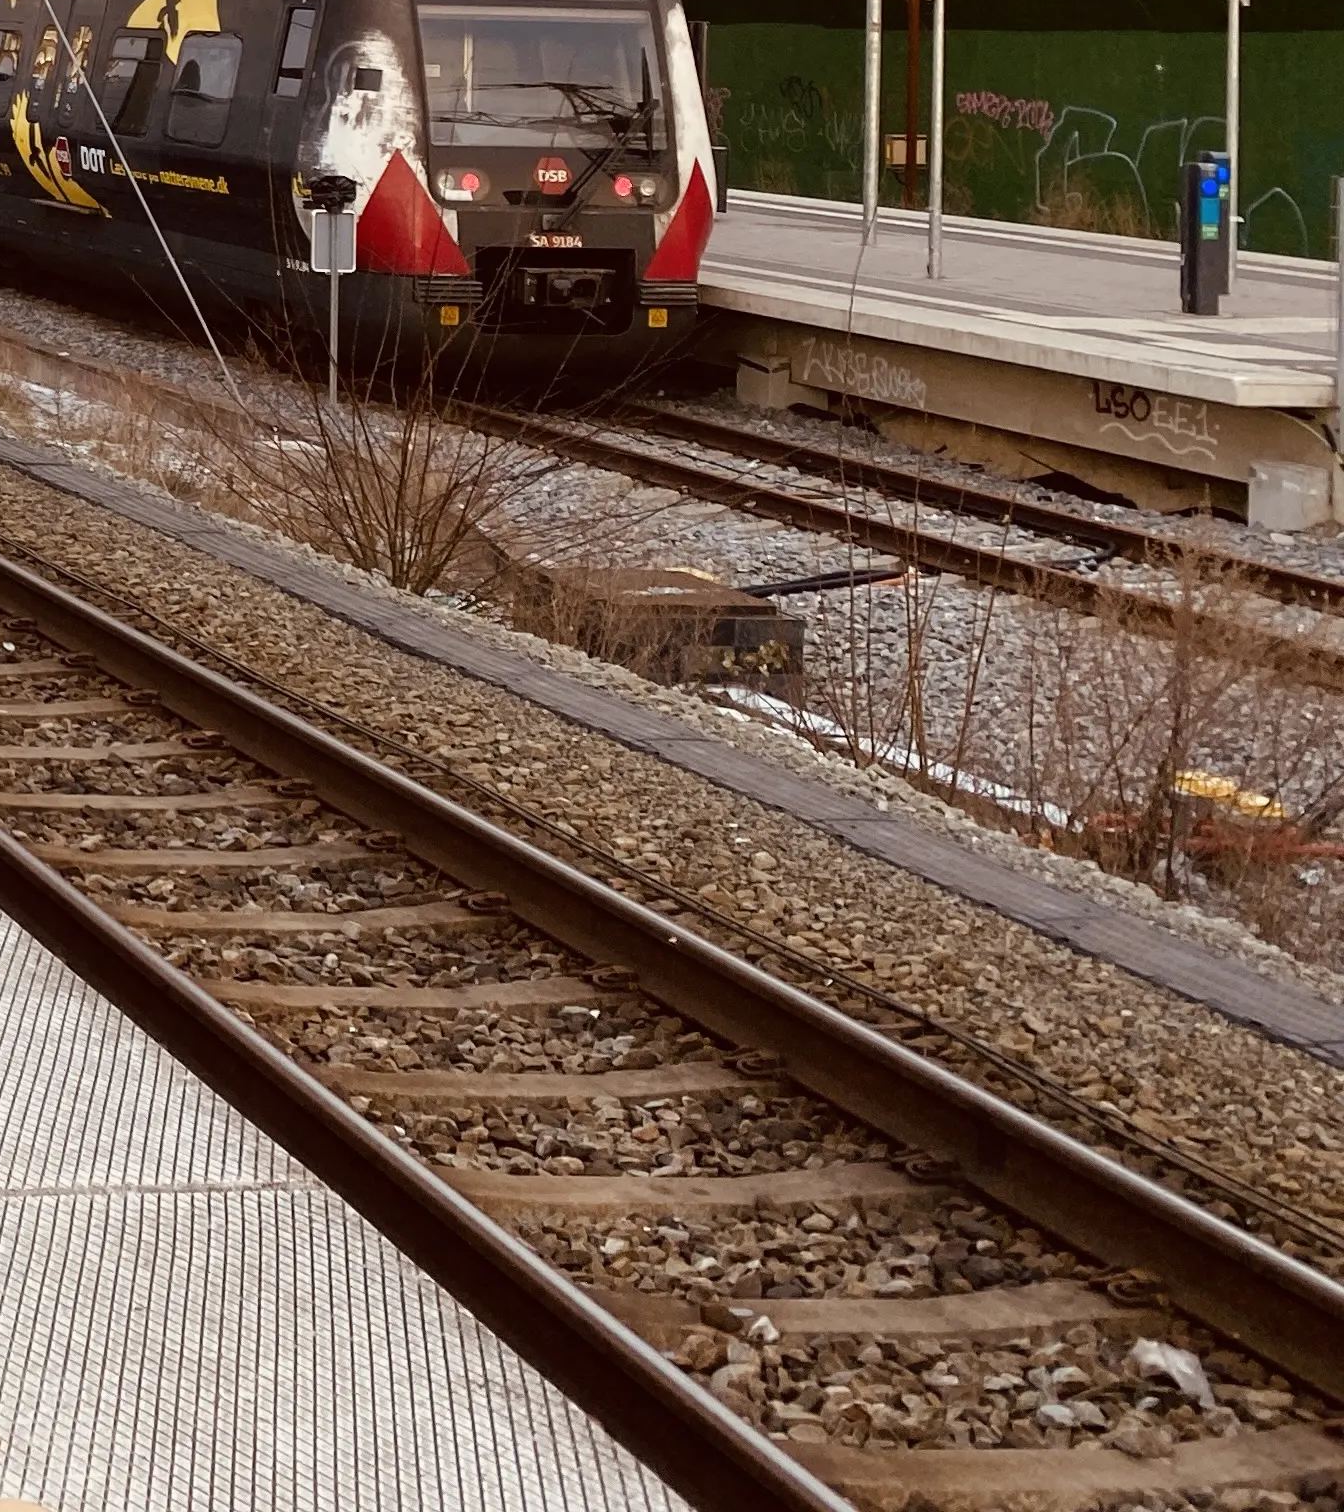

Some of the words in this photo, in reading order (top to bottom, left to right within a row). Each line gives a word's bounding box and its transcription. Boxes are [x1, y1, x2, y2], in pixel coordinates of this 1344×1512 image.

[80, 145, 106, 175] DOT
[538, 169, 568, 183] DSB
[531, 236, 549, 248] SA
[552, 236, 583, 248] 9184
